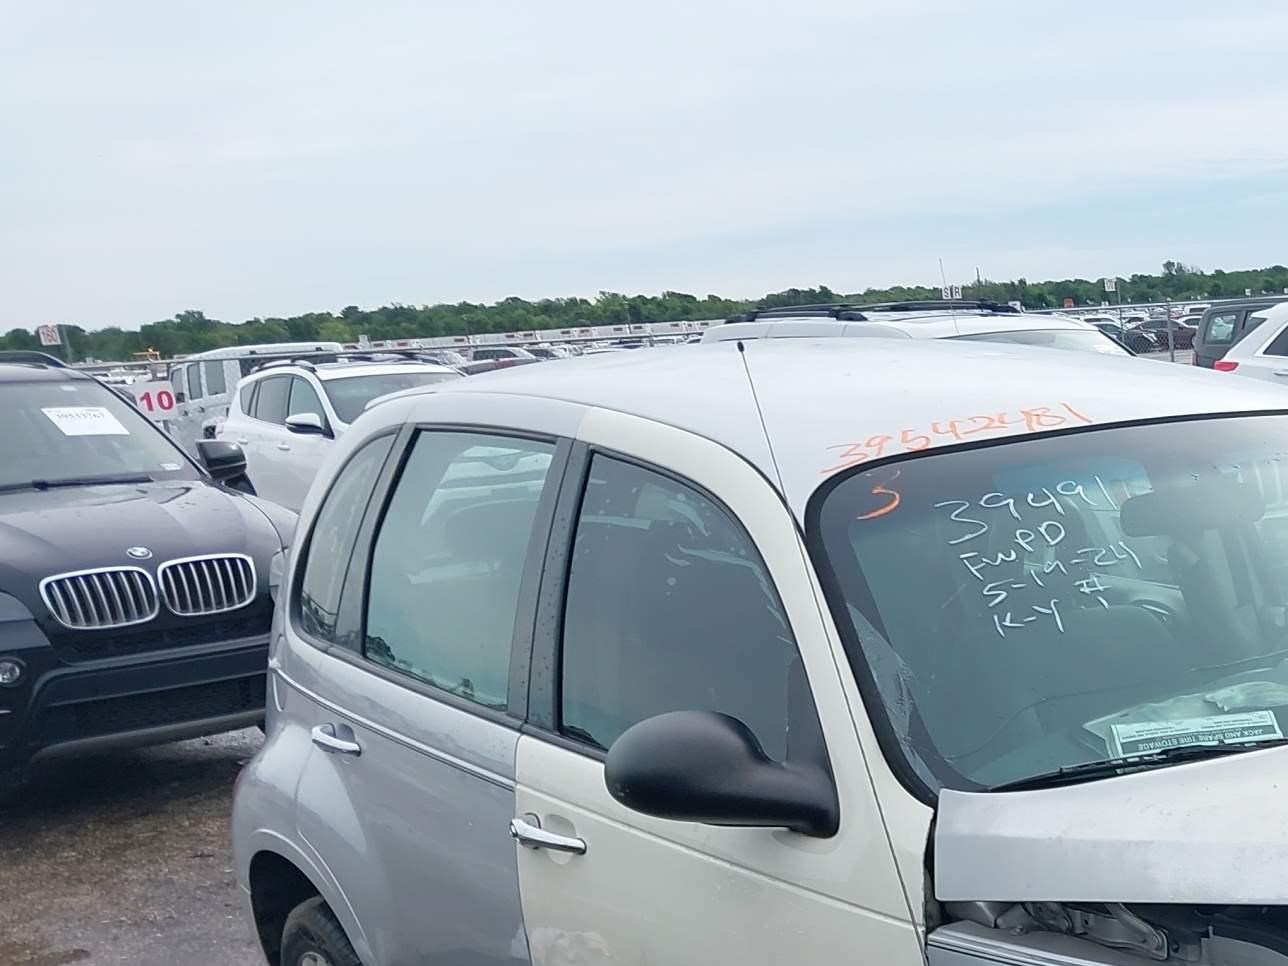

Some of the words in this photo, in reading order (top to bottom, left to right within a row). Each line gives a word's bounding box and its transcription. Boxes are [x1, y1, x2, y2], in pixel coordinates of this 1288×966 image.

[139, 390, 174, 411] 10
[820, 402, 1094, 474] 39542481
[934, 475, 1115, 544] 39491
[1198, 733, 1224, 742] SPARE
[1224, 731, 1242, 740] AND
[1243, 728, 1264, 737] JACK
[1137, 738, 1178, 750] STOWAGE
[1178, 736, 1197, 745] TIRE
